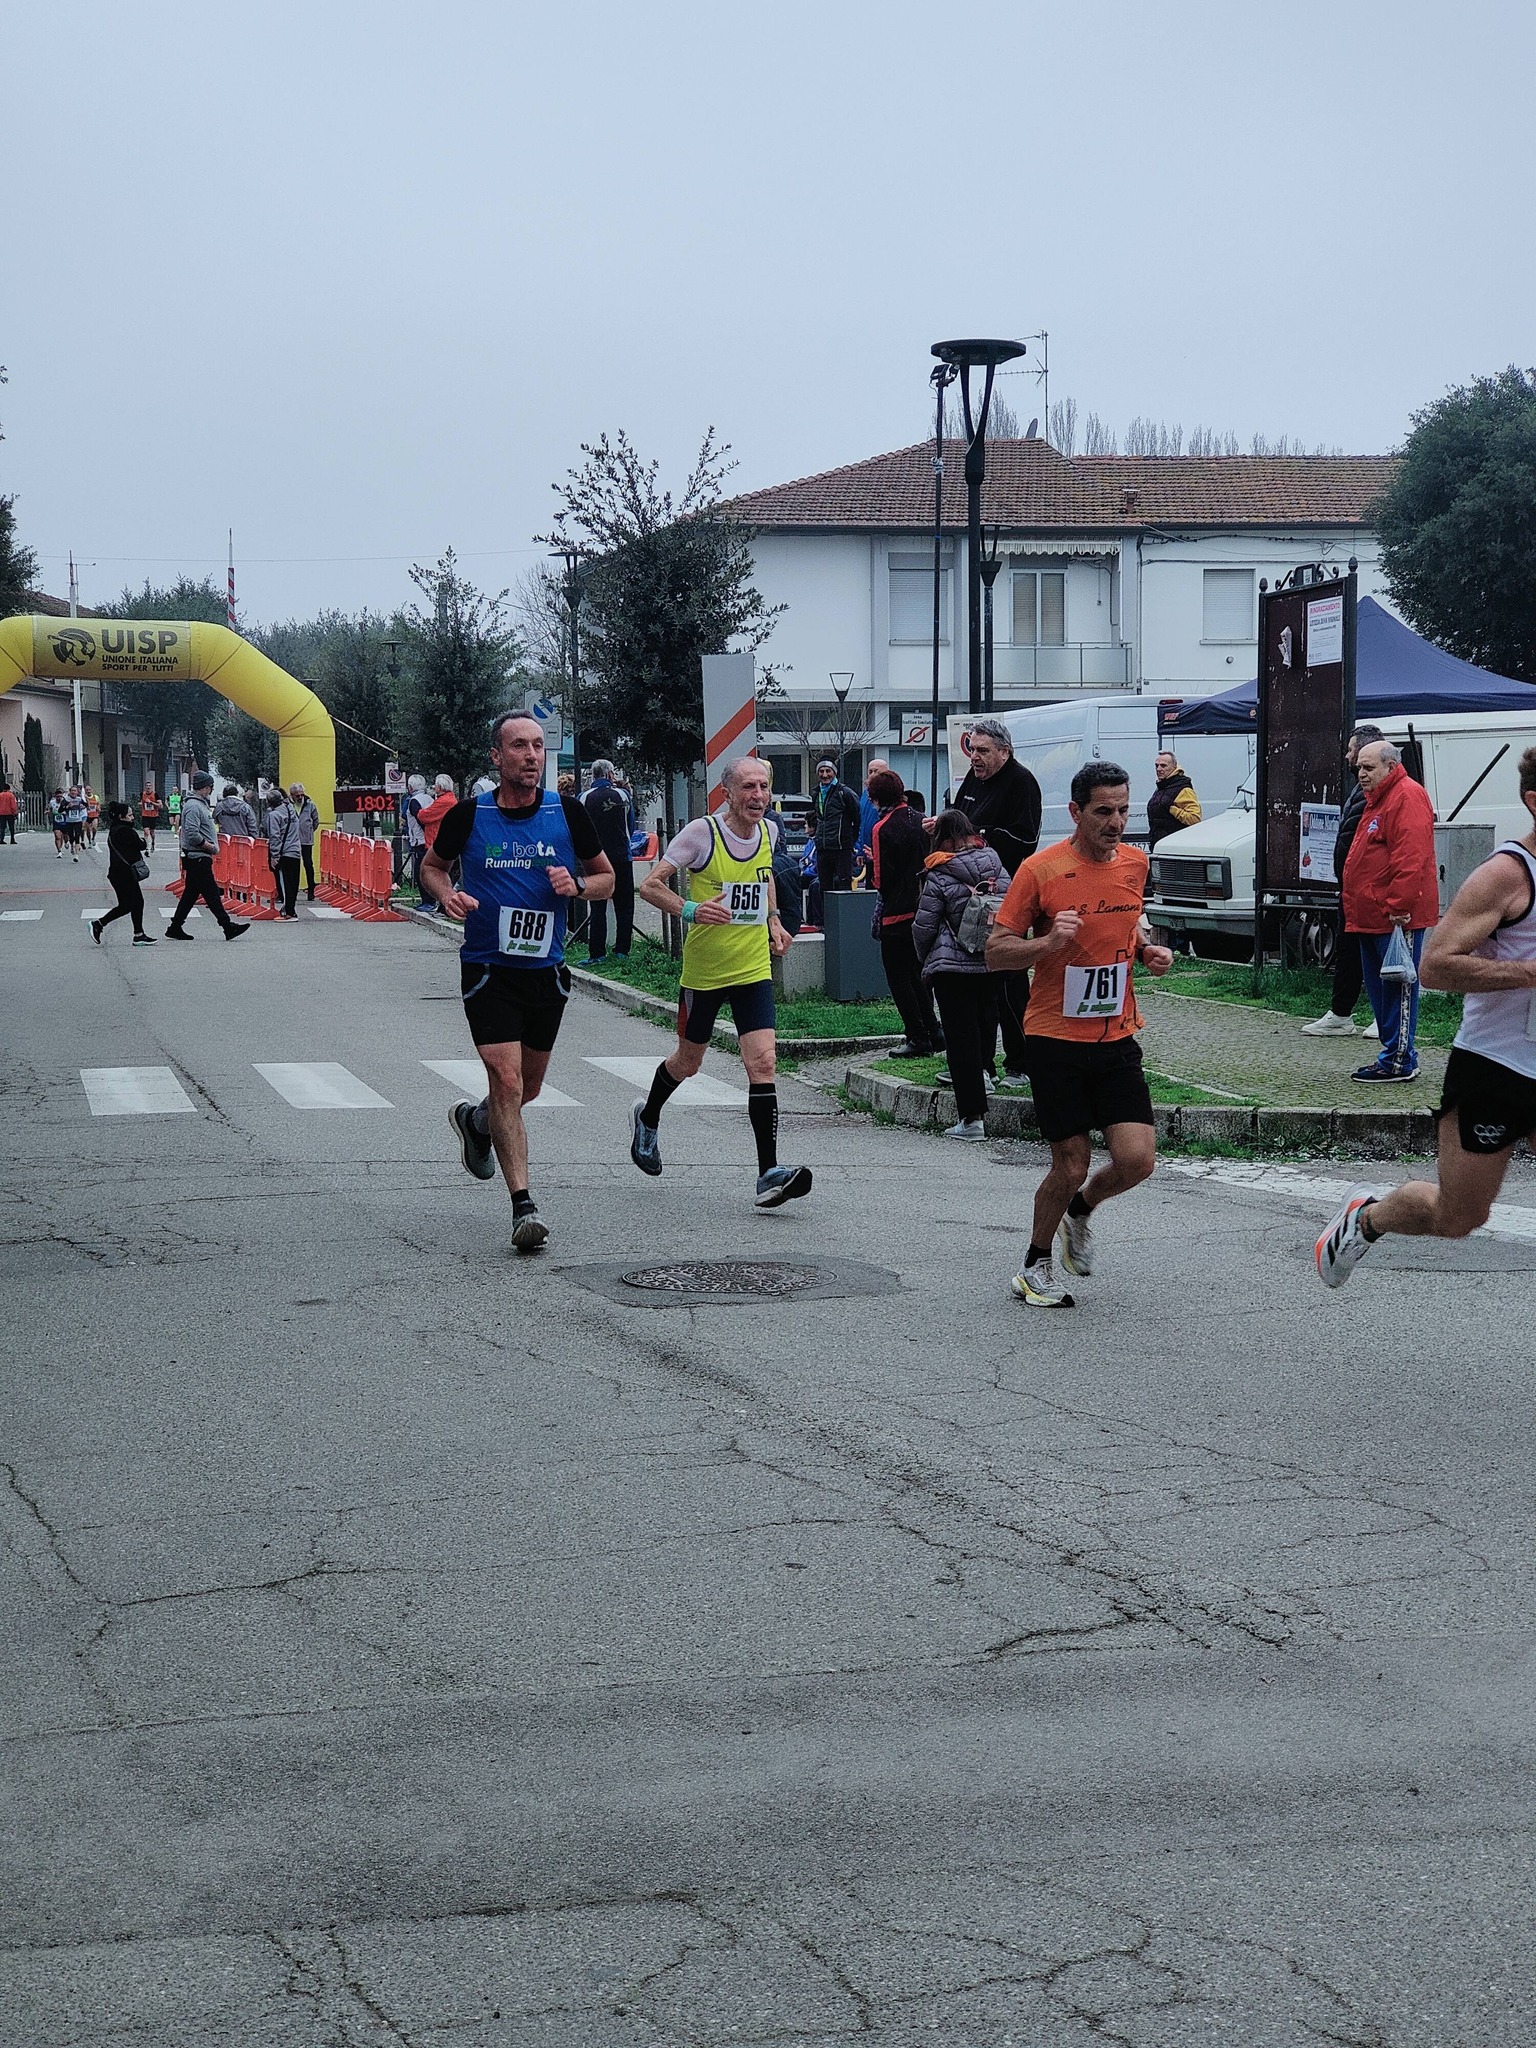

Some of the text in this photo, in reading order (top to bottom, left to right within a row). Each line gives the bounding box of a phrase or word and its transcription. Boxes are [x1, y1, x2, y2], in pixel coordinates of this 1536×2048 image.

[101, 629, 178, 654] UISP
[102, 655, 178, 664] UNIONE ITALIANA
[102, 663, 129, 671] SPORT
[485, 857, 532, 869] Running
[730, 884, 761, 911] 656
[509, 910, 547, 941] 688
[1083, 966, 1117, 1000] 761
